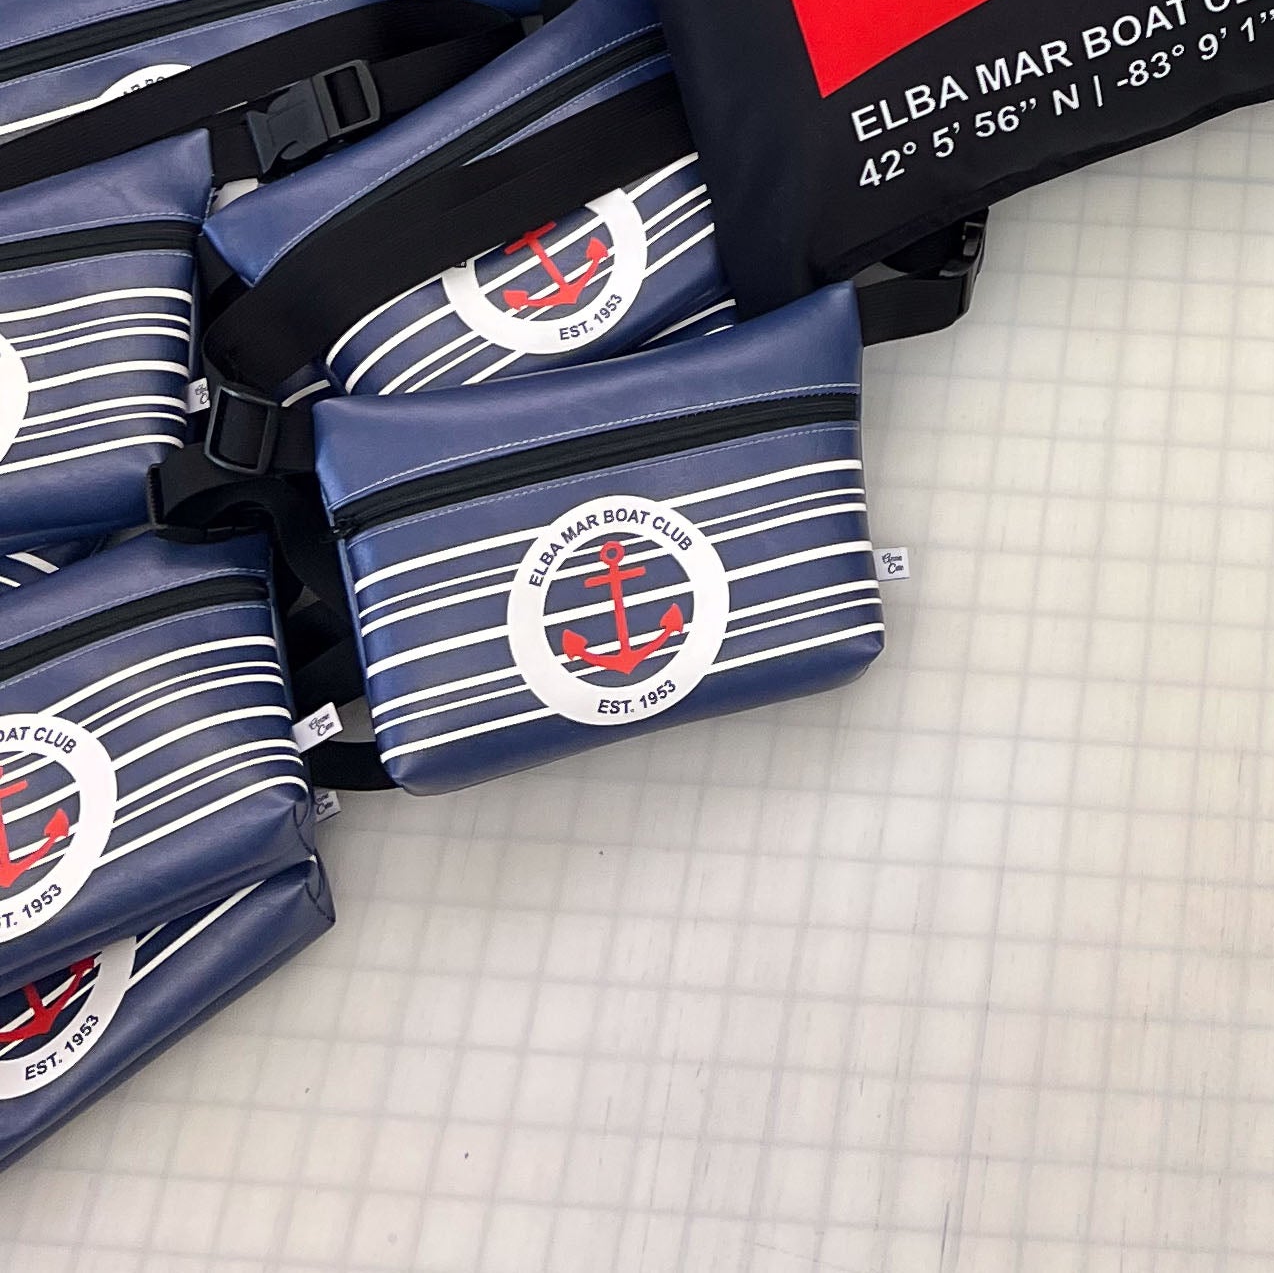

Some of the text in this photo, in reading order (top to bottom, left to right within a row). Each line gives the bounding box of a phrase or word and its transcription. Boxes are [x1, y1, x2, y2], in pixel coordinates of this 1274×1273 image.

[851, 75, 969, 142] ELBA
[975, 39, 1073, 95] MAR
[858, 141, 918, 187] 42°
[1052, 83, 1081, 117] N
[559, 293, 623, 341] EST. 1953
[528, 508, 693, 588] ELBA MAR BOAT CLUB
[597, 679, 676, 714] EST. 1953
[0, 726, 77, 754] AT CLUB
[22, 883, 62, 919] 1953
[25, 1014, 99, 1081] EST. 1953
